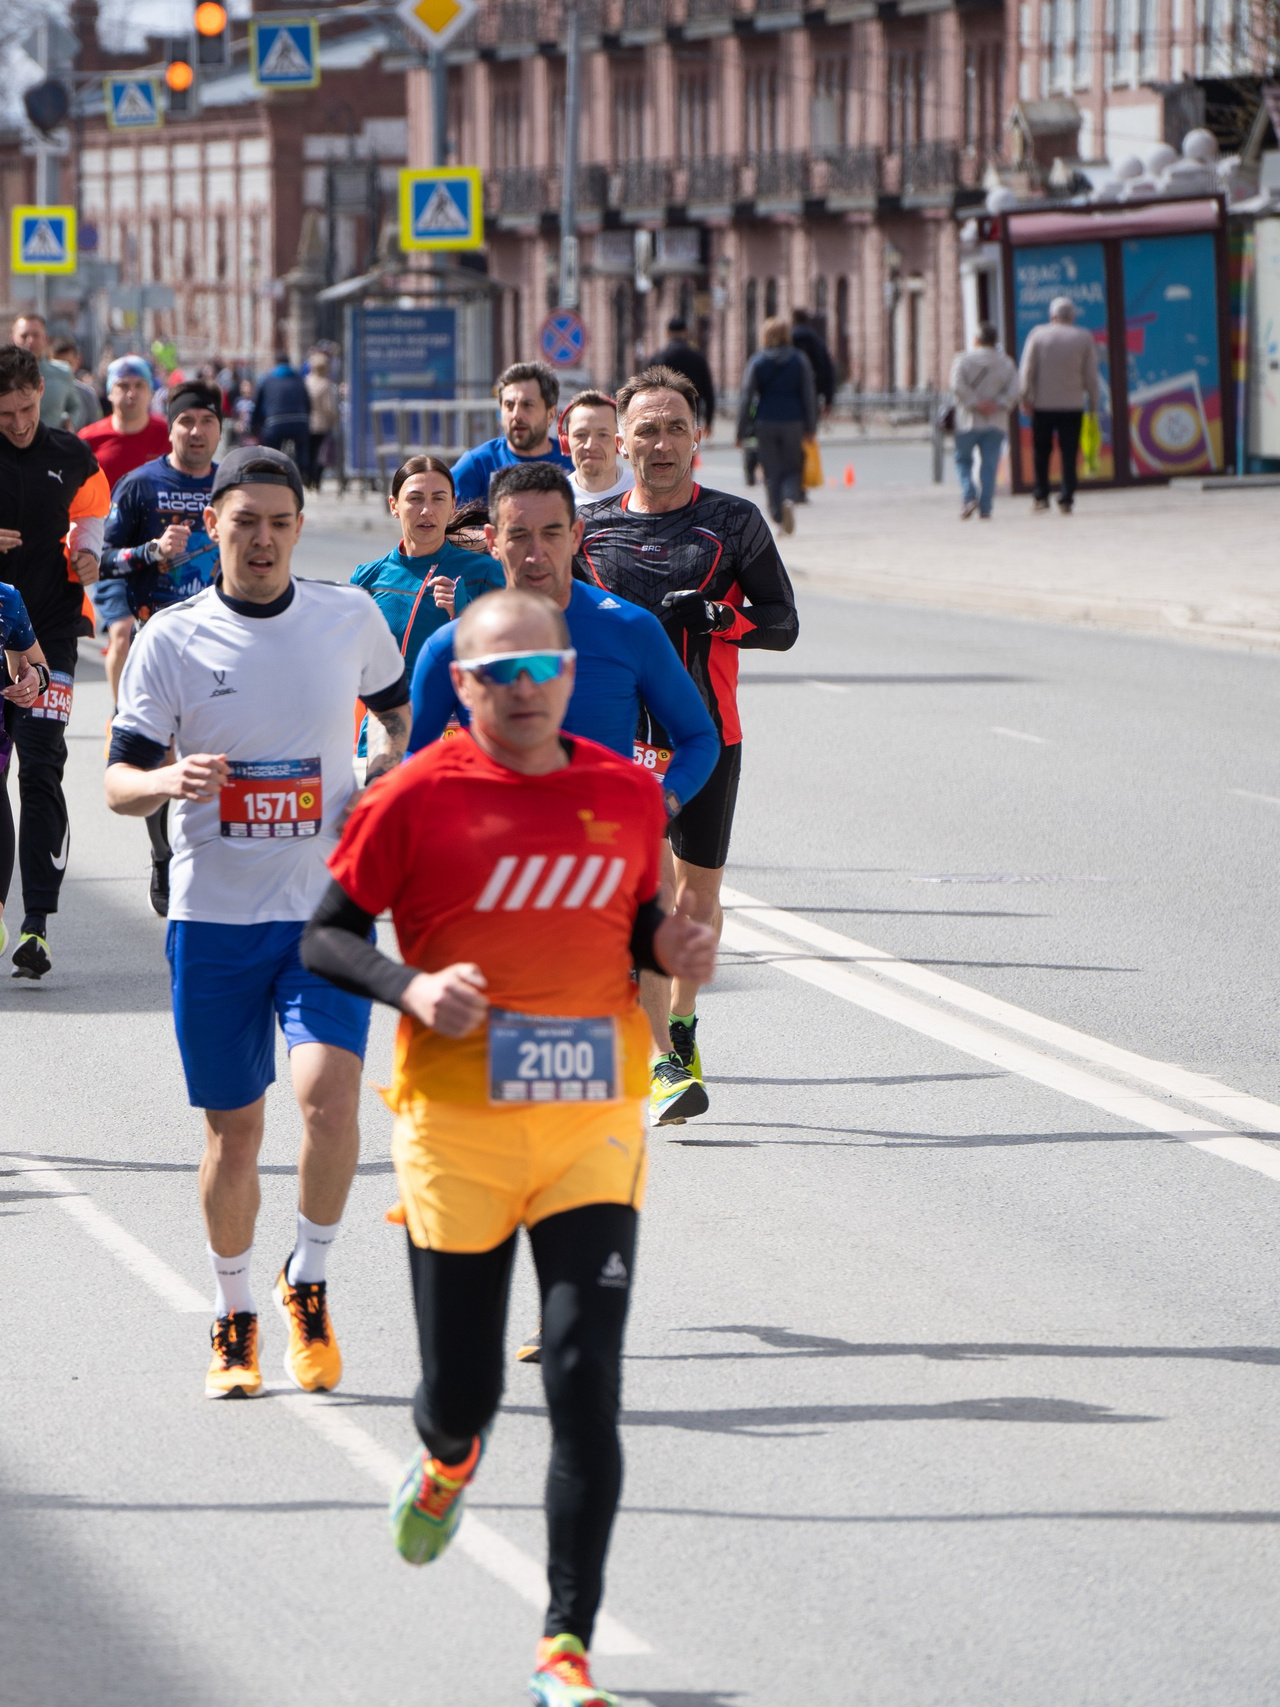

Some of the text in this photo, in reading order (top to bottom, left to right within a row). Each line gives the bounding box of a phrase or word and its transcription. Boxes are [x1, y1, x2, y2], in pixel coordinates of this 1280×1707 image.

[1017, 264, 1061, 281] КВАС
[43, 689, 71, 713] 1345
[244, 791, 298, 820] 1571
[517, 1040, 595, 1079] 2100
